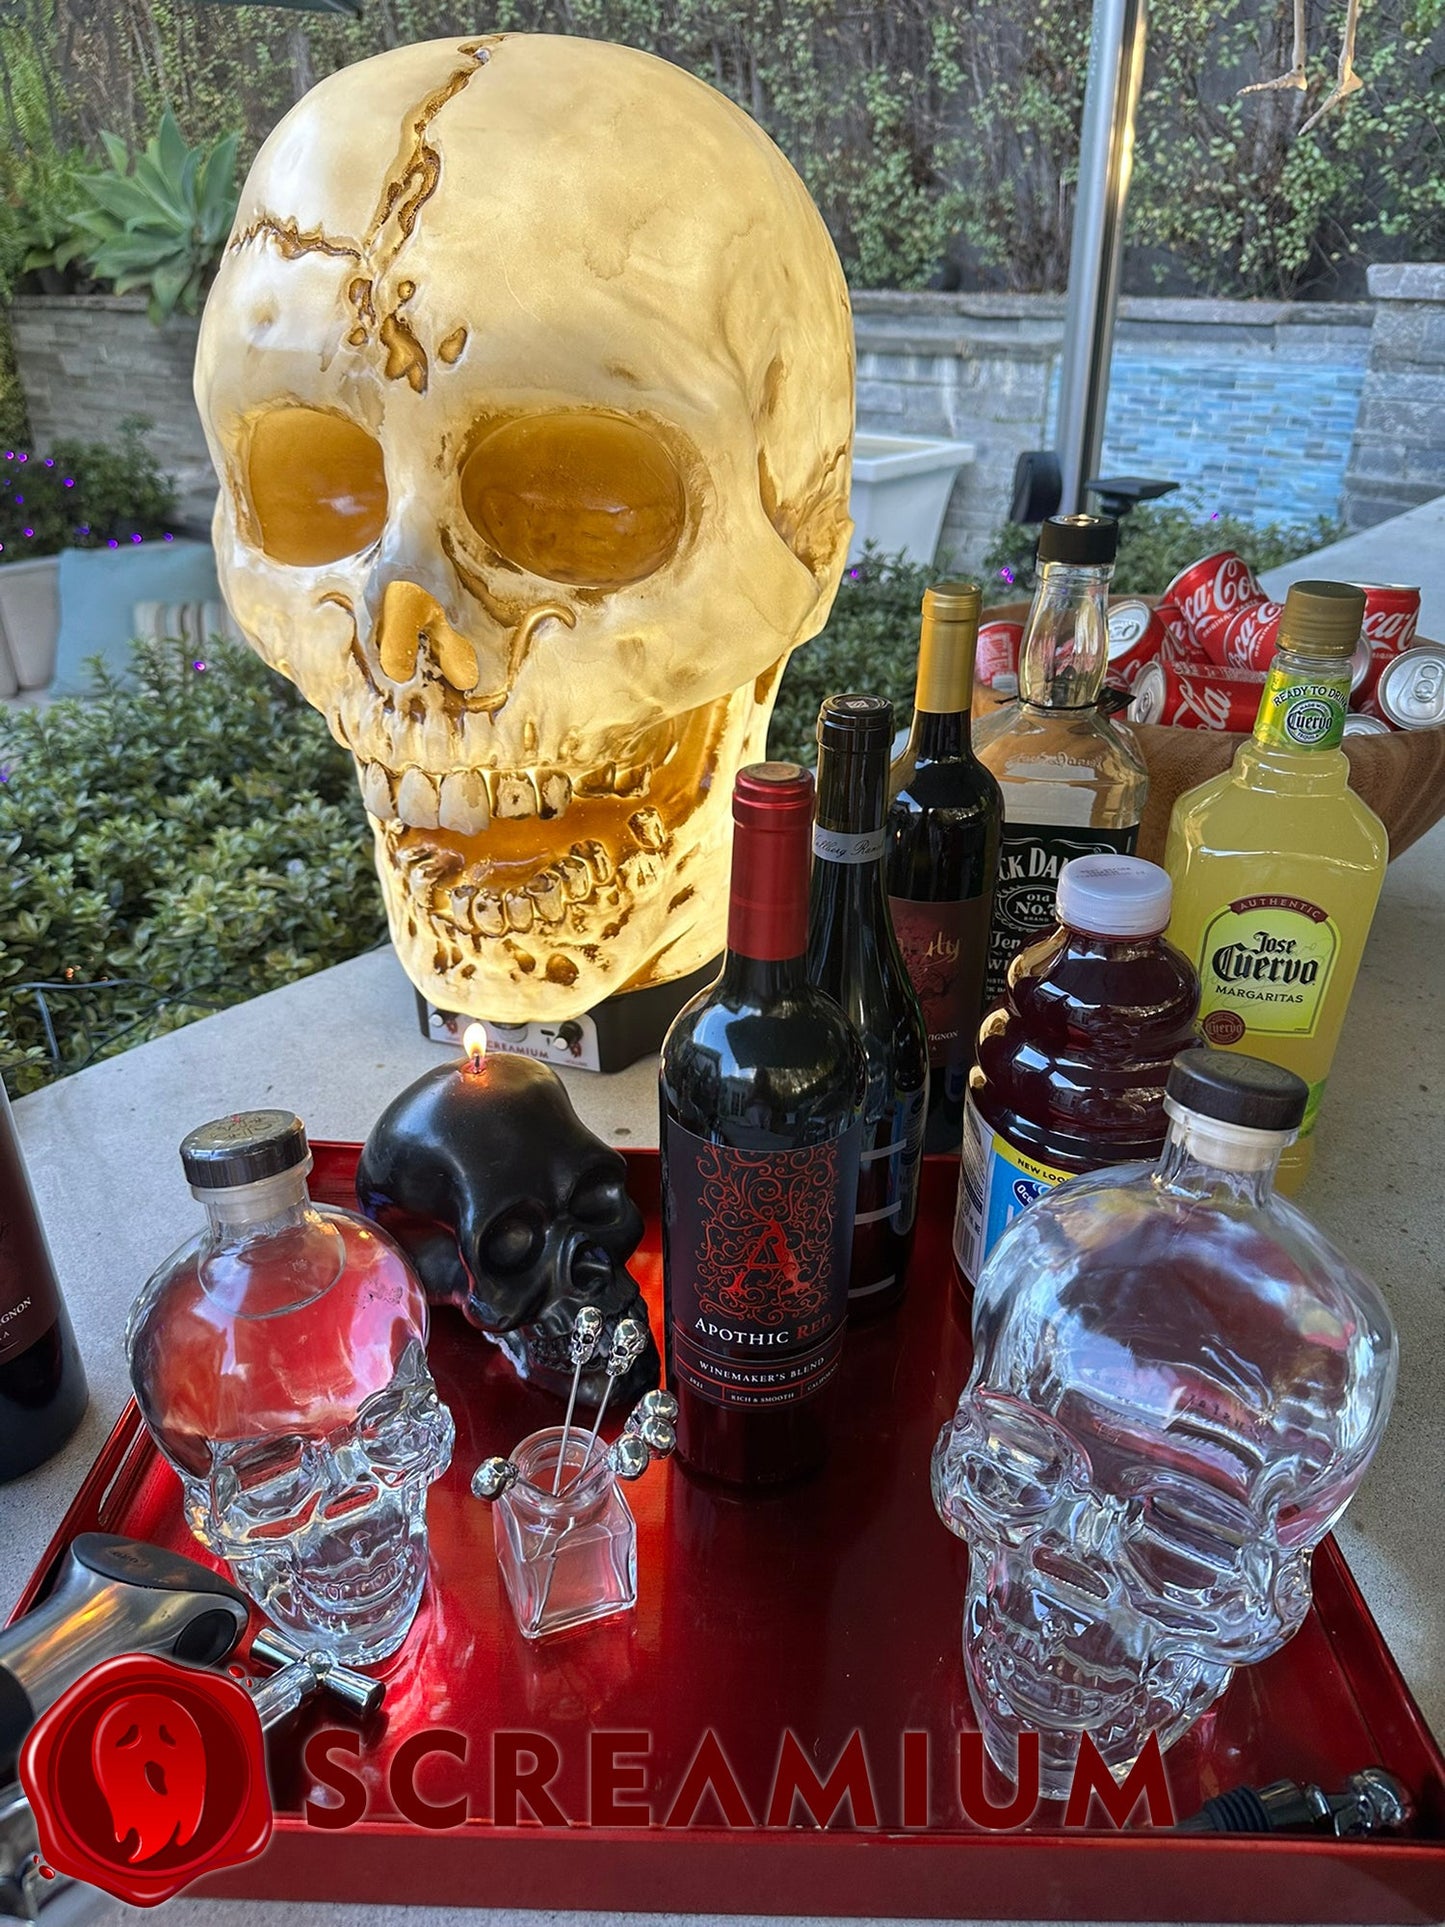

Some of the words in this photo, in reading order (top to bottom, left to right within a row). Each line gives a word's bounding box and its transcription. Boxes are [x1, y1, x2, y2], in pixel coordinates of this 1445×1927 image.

[1273, 685, 1309, 707] READY
[1311, 686, 1327, 696] TO
[1287, 710, 1333, 731] Cuervo
[1239, 897, 1322, 919] AUTHENTIC
[1253, 930, 1298, 955] Jose
[1211, 942, 1319, 986] Cuervo
[1215, 985, 1304, 1003] MARGARITAS
[486, 1040, 549, 1059] CREAMIUM
[1017, 1157, 1040, 1176] NEW
[694, 1317, 790, 1346] APOTHIC
[700, 1360, 787, 1384] WINEMAKER'S
[790, 1357, 826, 1378] BLEND
[731, 1394, 751, 1403] RICH
[760, 1392, 795, 1404] SMOOTH
